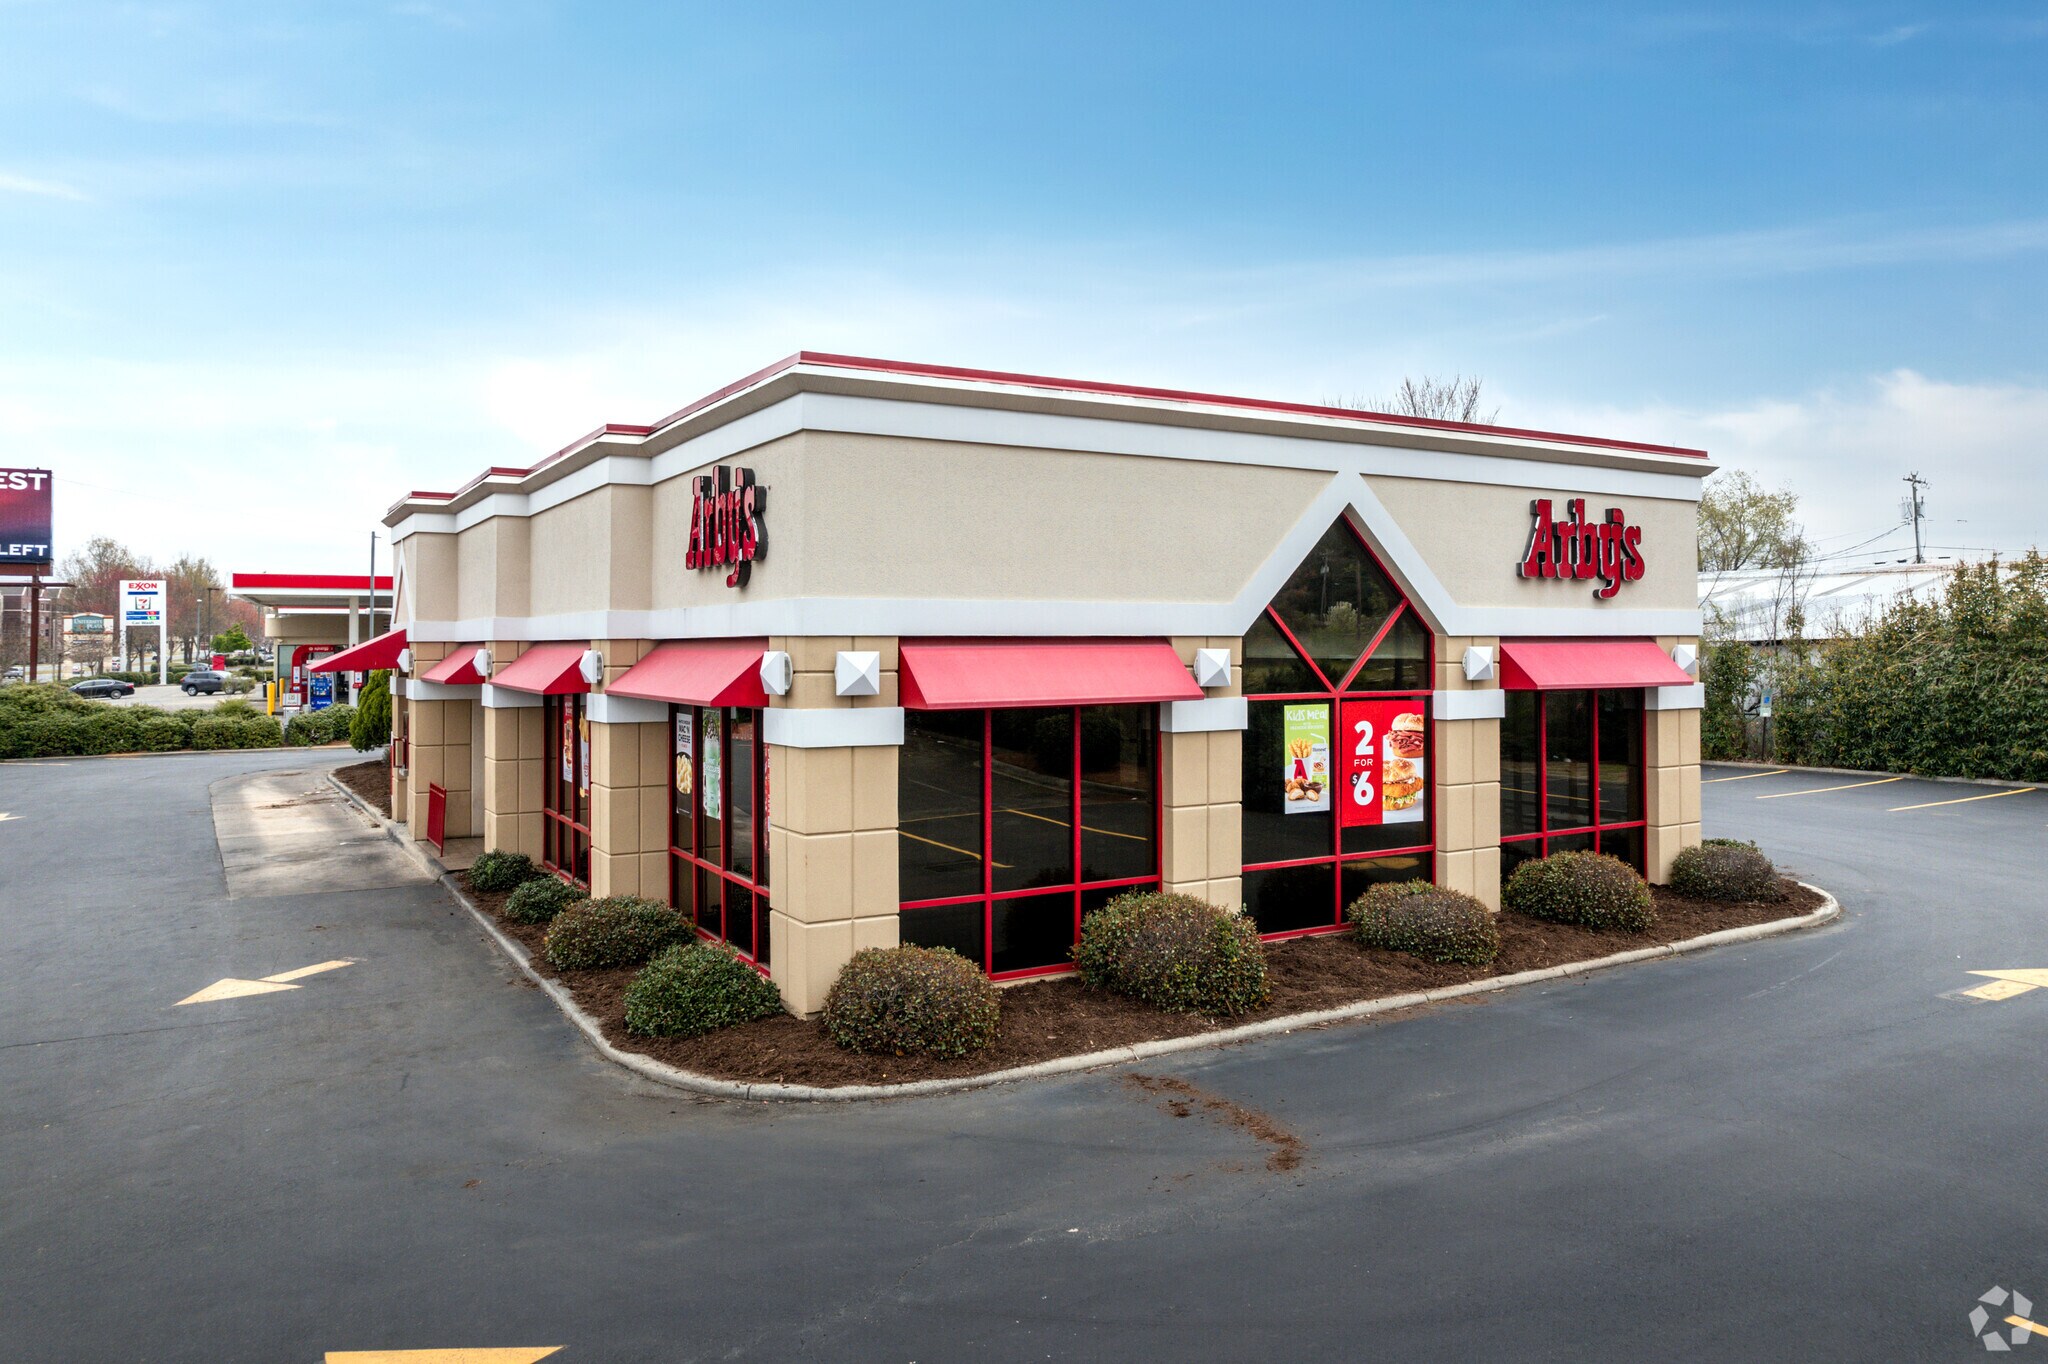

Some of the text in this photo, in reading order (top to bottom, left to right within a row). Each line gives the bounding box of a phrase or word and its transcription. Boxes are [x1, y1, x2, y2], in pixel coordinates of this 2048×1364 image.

[686, 465, 767, 588] Arby's
[1518, 498, 1645, 599] Arby's
[128, 582, 158, 591] EXXON
[1354, 720, 1374, 756] 2
[1354, 758, 1373, 767] FOR
